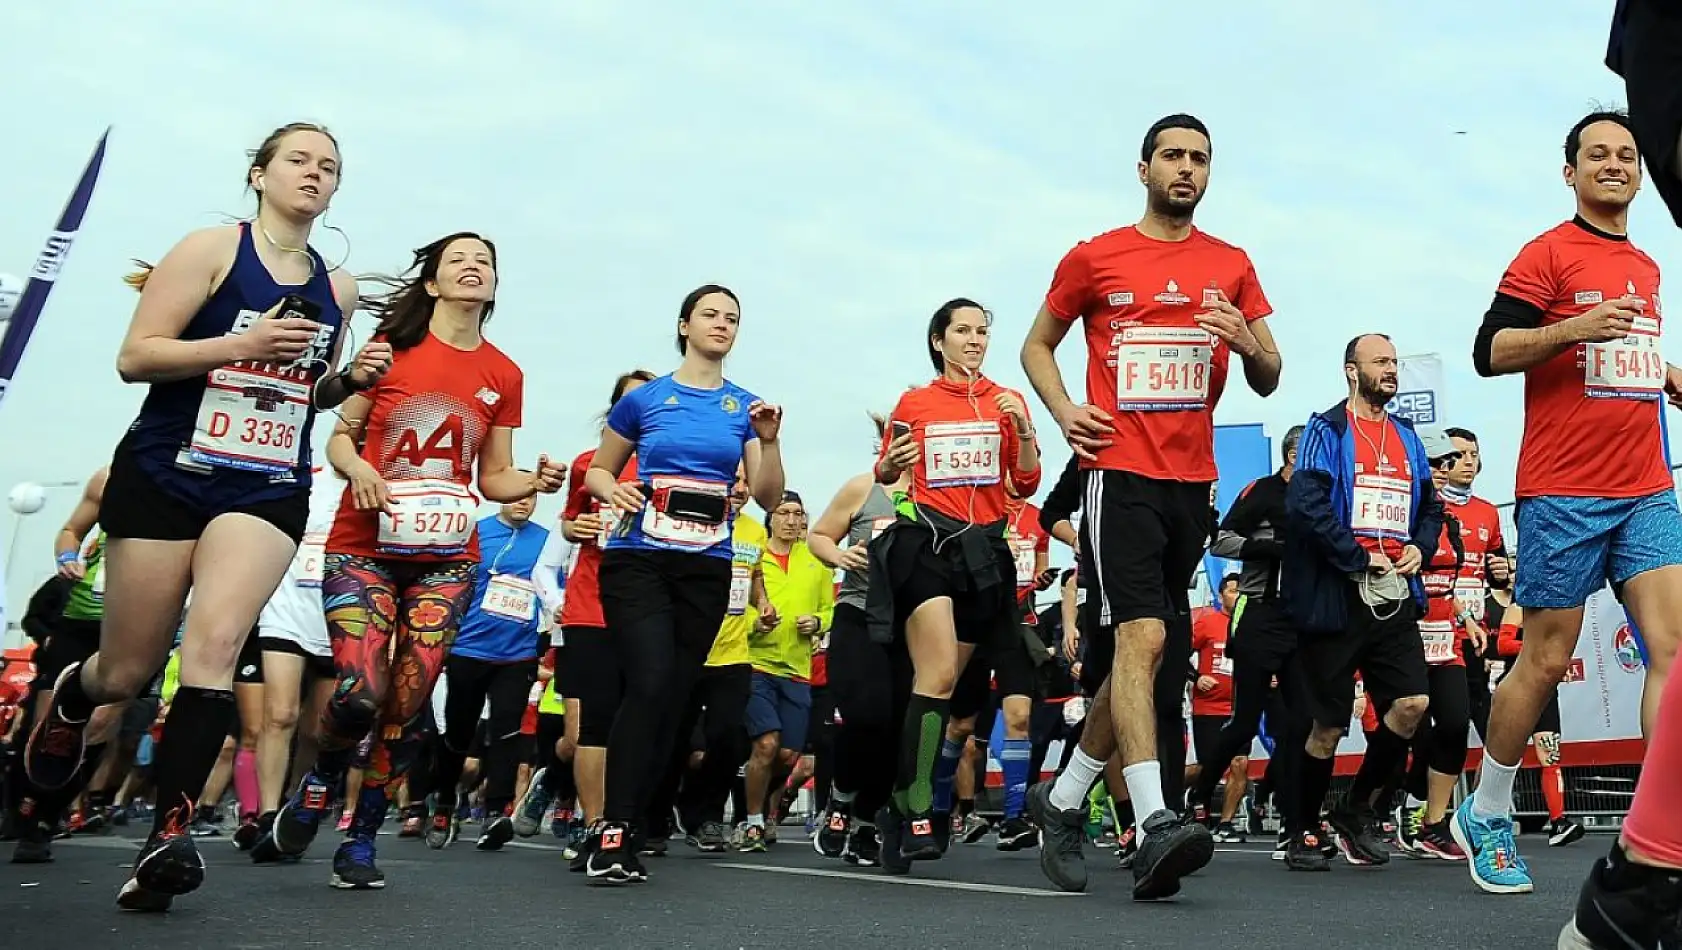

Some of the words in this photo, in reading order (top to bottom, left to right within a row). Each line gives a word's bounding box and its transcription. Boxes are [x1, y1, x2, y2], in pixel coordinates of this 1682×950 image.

[1592, 347, 1607, 377] F
[1614, 349, 1661, 380] 5419
[1126, 362, 1139, 390] F
[1149, 362, 1204, 390] 5418
[209, 411, 231, 438] D
[240, 417, 296, 449] 3336
[933, 453, 943, 470] F
[949, 449, 992, 469] 5343
[392, 512, 404, 533] F
[414, 512, 468, 533] 5270
[1361, 502, 1370, 519] F
[1376, 503, 1406, 523] 5006
[306, 557, 316, 572] C
